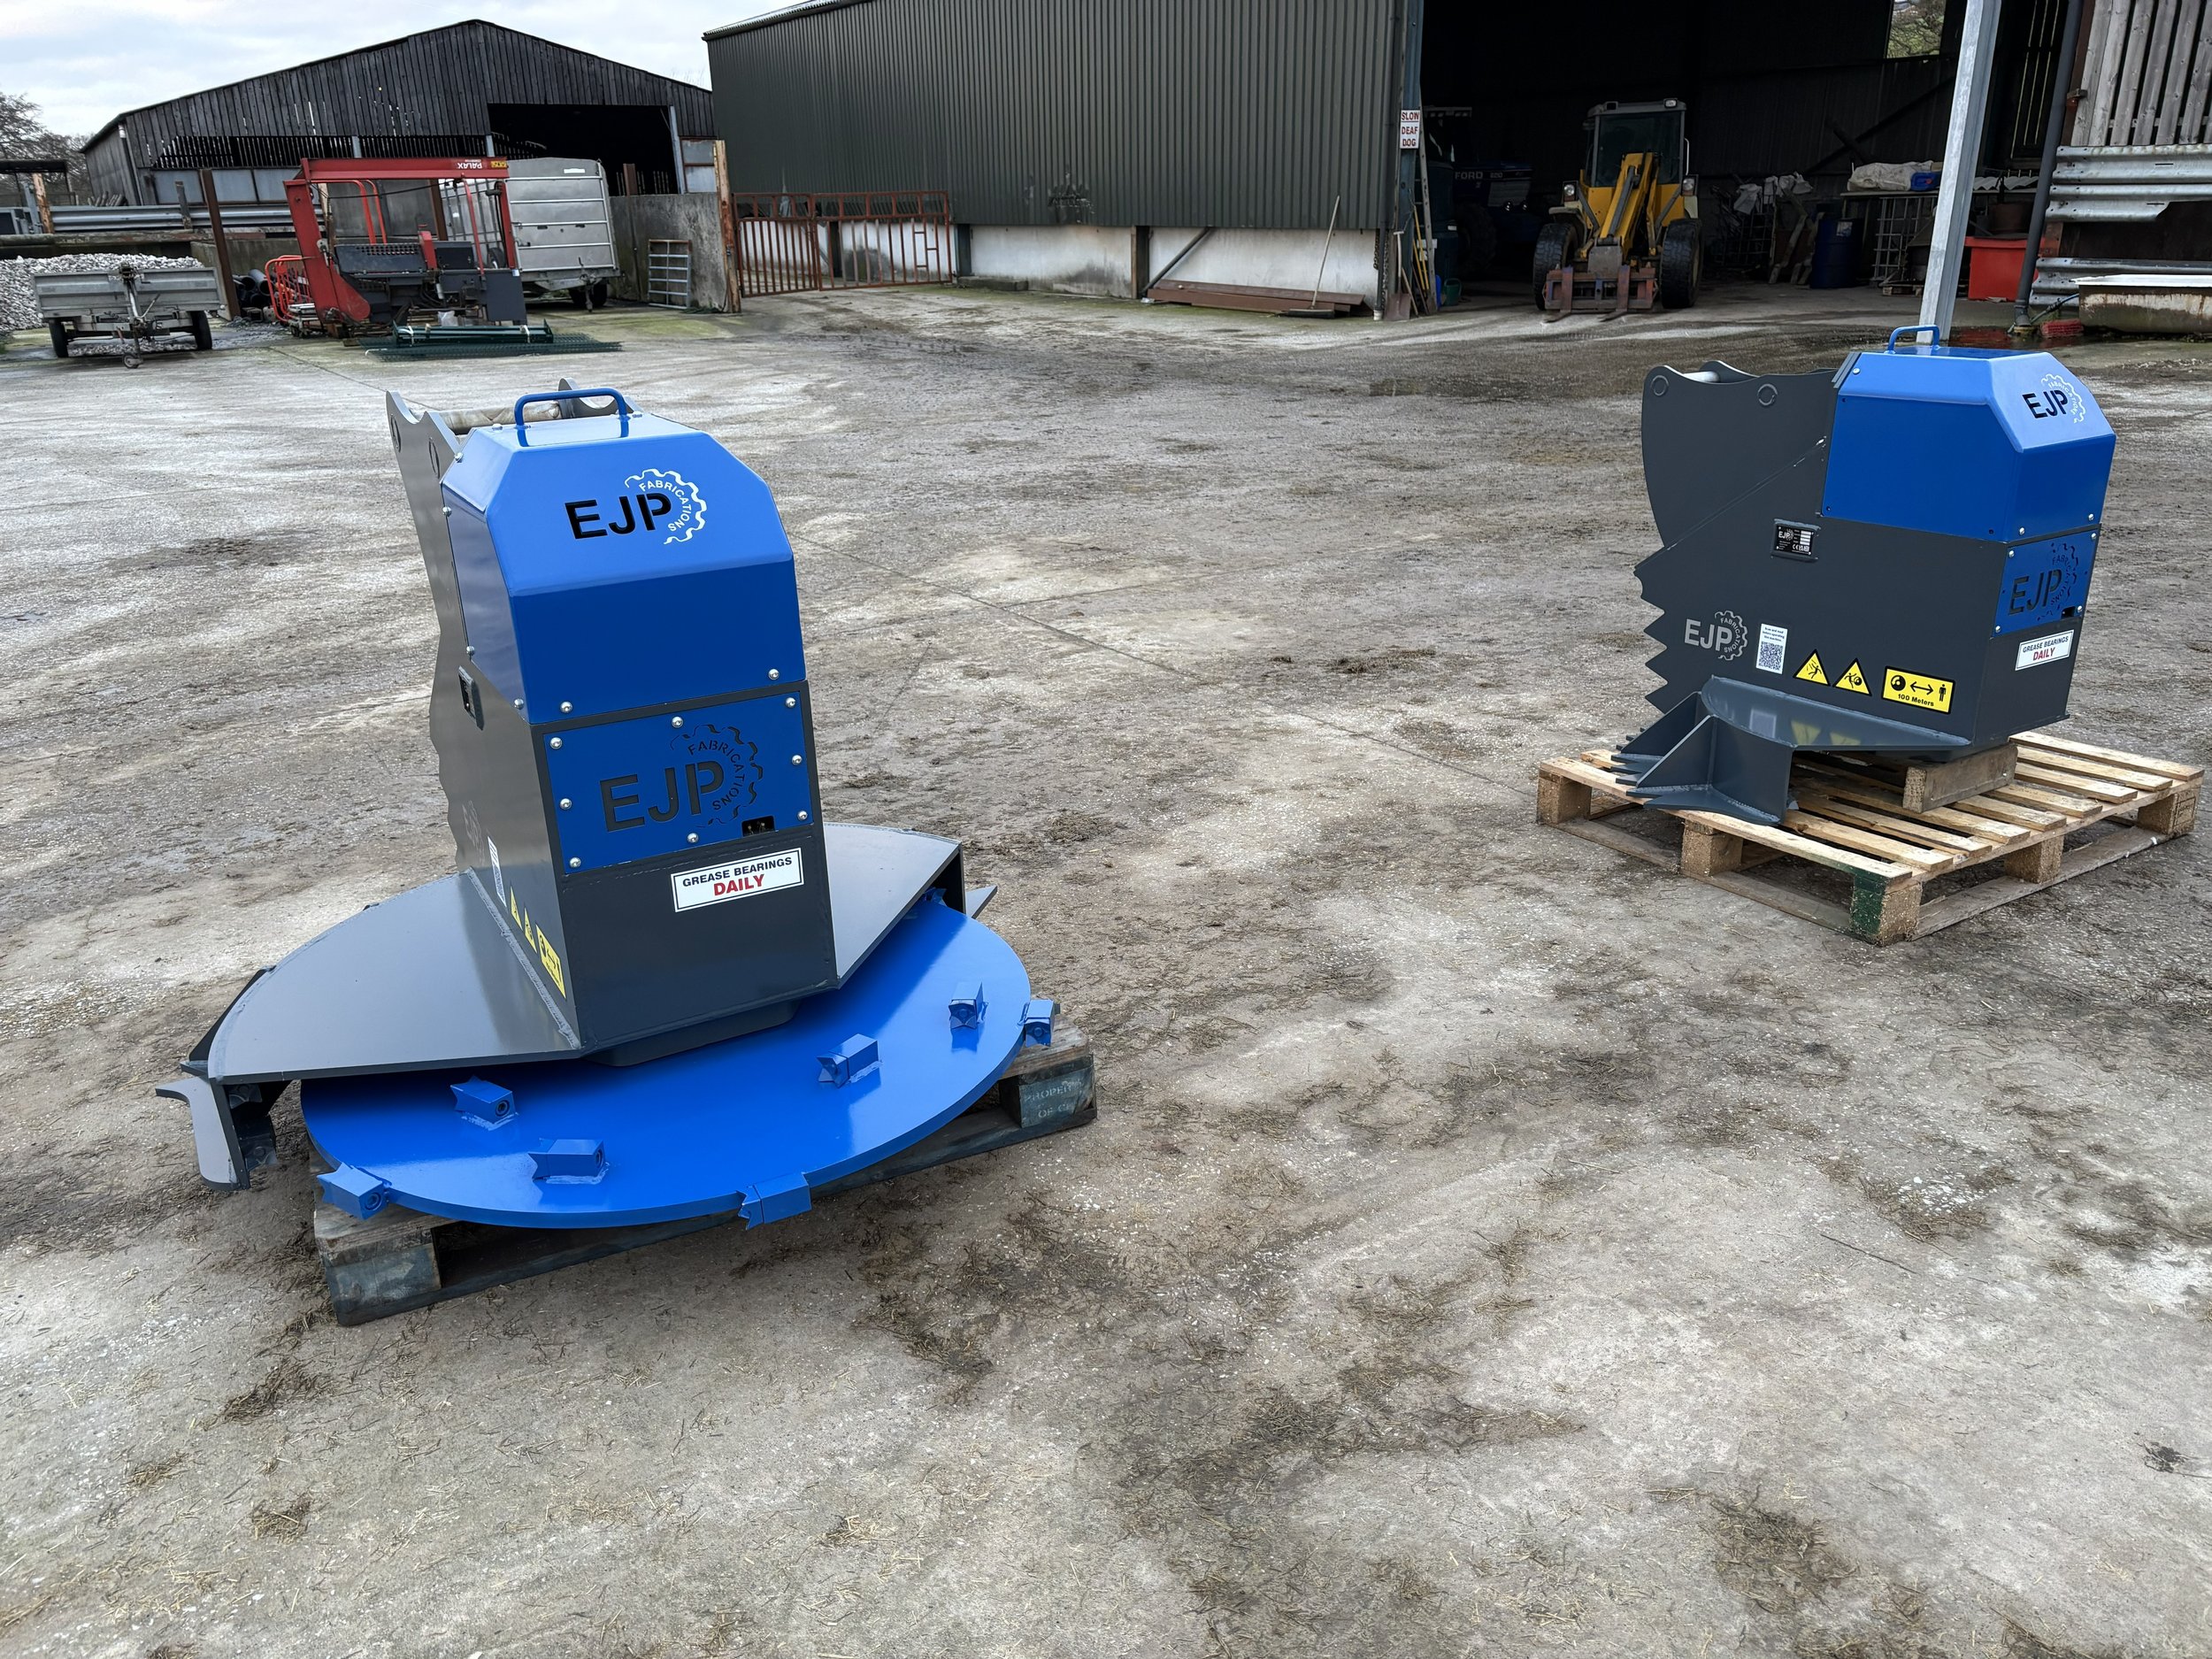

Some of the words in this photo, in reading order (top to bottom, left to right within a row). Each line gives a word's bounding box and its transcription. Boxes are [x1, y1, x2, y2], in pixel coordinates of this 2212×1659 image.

[1402, 111, 1419, 120] SLOW
[1402, 126, 1418, 134] DEAF
[1402, 138, 1417, 147] DOG
[1455, 171, 1484, 180] FORD
[2022, 389, 2069, 419] EJP
[565, 492, 672, 540] EJP
[638, 480, 692, 532] FABRICATIONS
[2008, 569, 2062, 616] EJP
[1684, 618, 1733, 651] EJP
[1720, 618, 1741, 653] FABRICATIONS
[2023, 641, 2043, 653] GREASE
[2043, 635, 2069, 648] BEARINGS
[2033, 647, 2055, 661] DAILY
[687, 740, 745, 811] FABRICATIONS
[600, 760, 724, 832] EJP
[682, 870, 731, 887] GREASE
[733, 856, 793, 877] BEARINGS
[713, 874, 764, 896] DAILY
